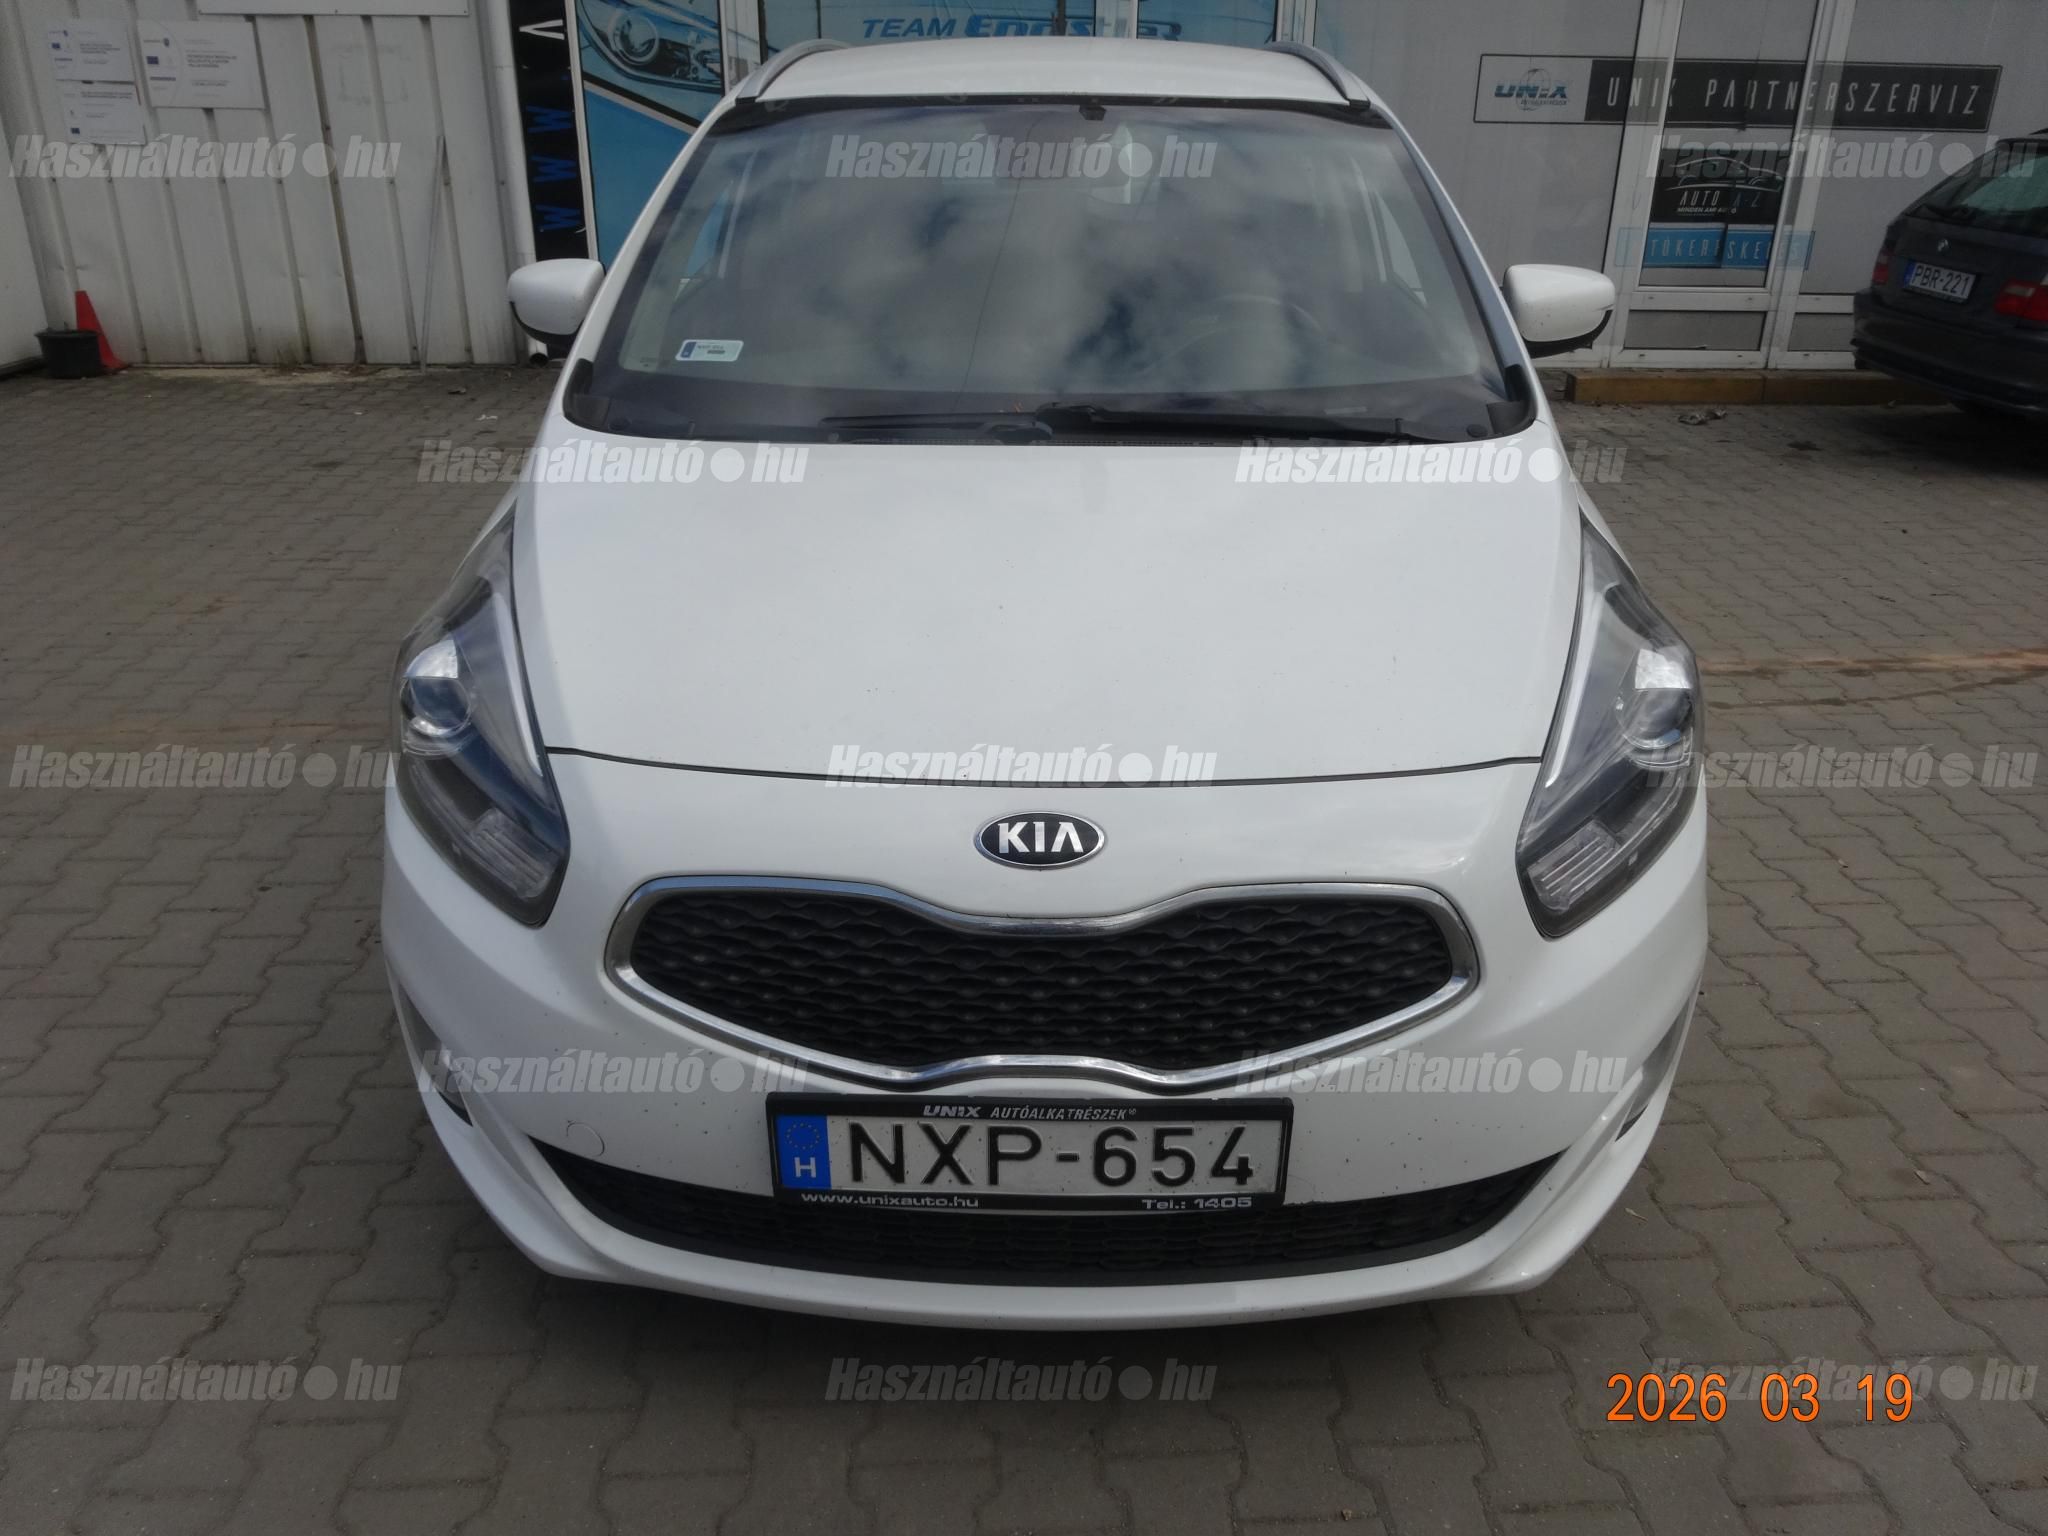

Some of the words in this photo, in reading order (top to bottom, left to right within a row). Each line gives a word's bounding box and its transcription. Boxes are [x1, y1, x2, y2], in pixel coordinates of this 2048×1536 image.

[862, 15, 955, 38] TEAM
[1705, 79, 1980, 115] PARTNERSZERVIZ
[1679, 190, 1720, 206] AUTO
[1911, 264, 1970, 297] PBR-221
[998, 821, 1084, 853] KIA
[923, 1105, 982, 1118] UNIX
[849, 1121, 1254, 1188] NXP-654
[794, 1157, 817, 1179] H
[801, 1191, 979, 1208] www.unixauto.hu
[1142, 1198, 1186, 1210] Tel.:
[1195, 1196, 1252, 1209] 1405
